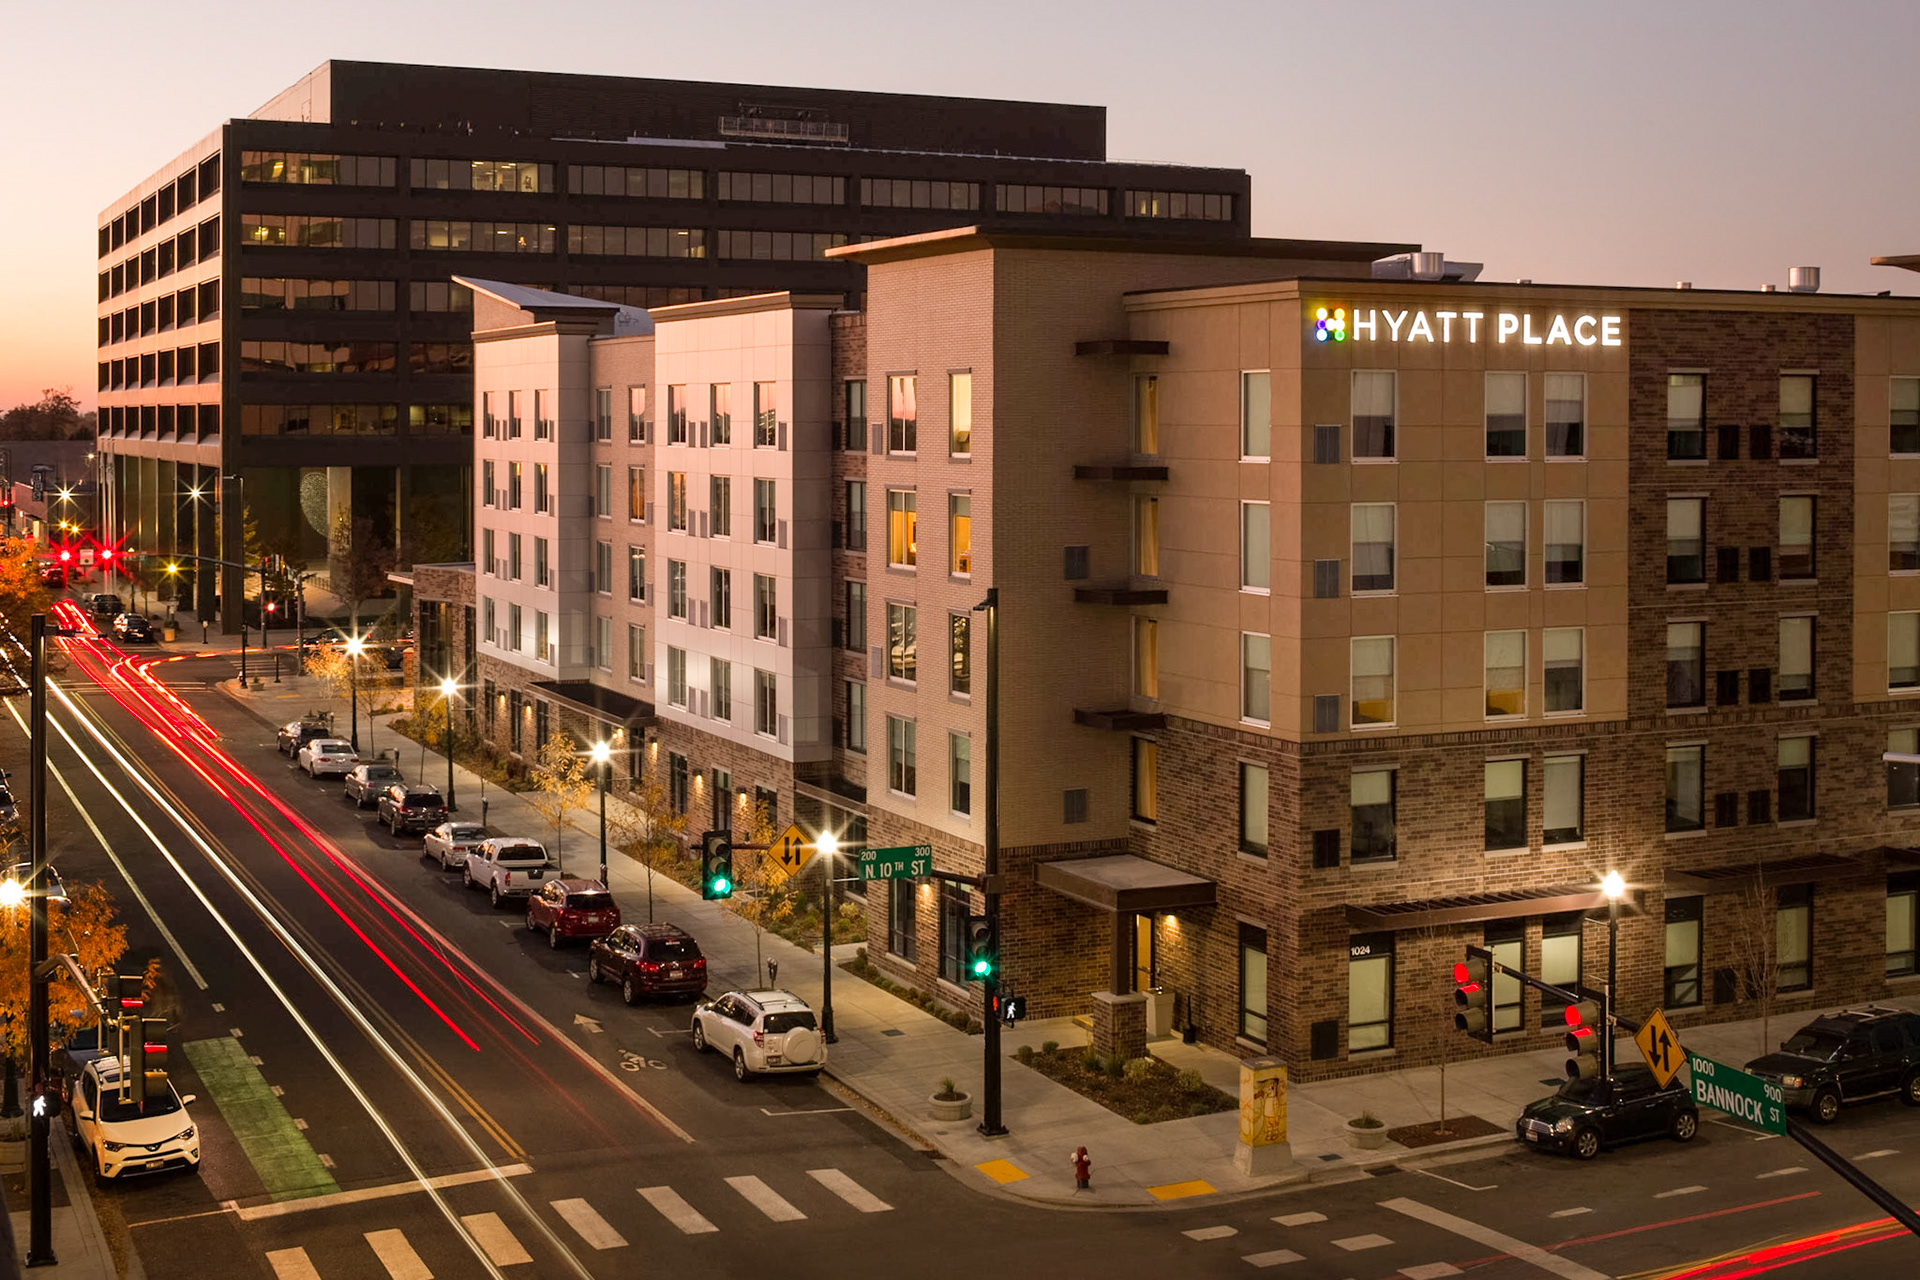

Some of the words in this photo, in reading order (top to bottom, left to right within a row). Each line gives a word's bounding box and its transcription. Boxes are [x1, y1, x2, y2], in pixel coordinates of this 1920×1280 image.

[1352, 309, 1484, 343] HYATT
[1498, 313, 1622, 346] PLACE
[861, 851, 877, 861] 200
[915, 846, 931, 857] 300
[865, 864, 876, 879] N.
[880, 861, 904, 878] 10TH
[911, 860, 926, 875] ST
[1350, 945, 1371, 956] 1024
[1692, 1057, 1714, 1077] 1000
[1763, 1083, 1782, 1103] 900
[1696, 1078, 1764, 1125] BANNOCK
[1769, 1107, 1780, 1123] ST
